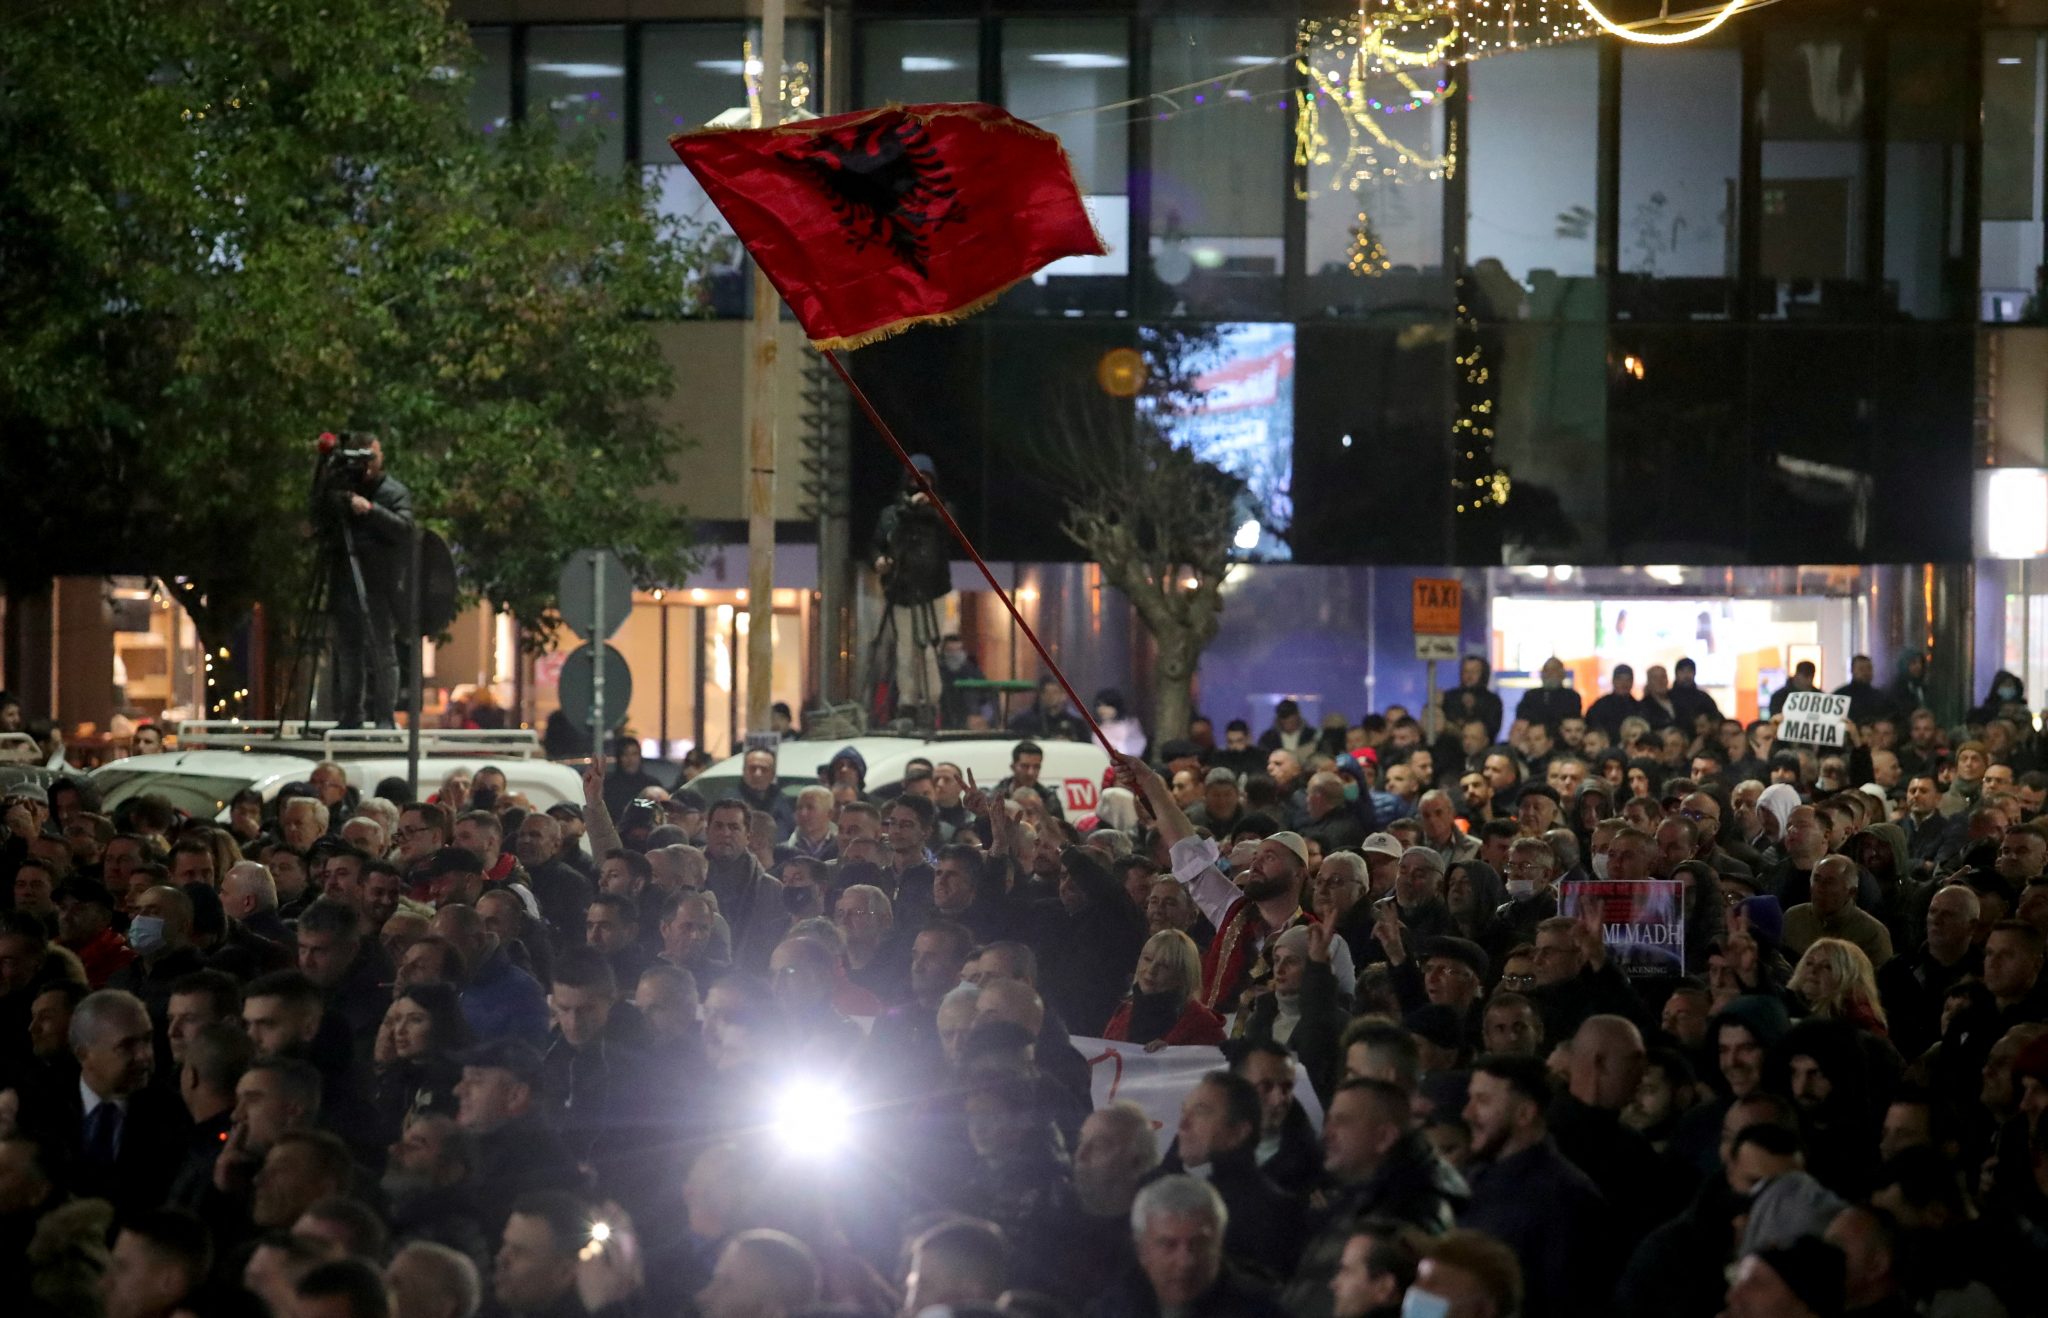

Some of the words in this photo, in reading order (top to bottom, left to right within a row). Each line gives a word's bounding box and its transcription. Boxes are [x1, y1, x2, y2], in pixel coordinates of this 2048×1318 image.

[1419, 584, 1457, 608] TAXI
[1788, 694, 1845, 715] SOROS
[1784, 720, 1836, 743] MAFIA
[1066, 783, 1093, 806] TV
[1625, 923, 1682, 945] MADH
[1626, 966, 1668, 975] AKENING
